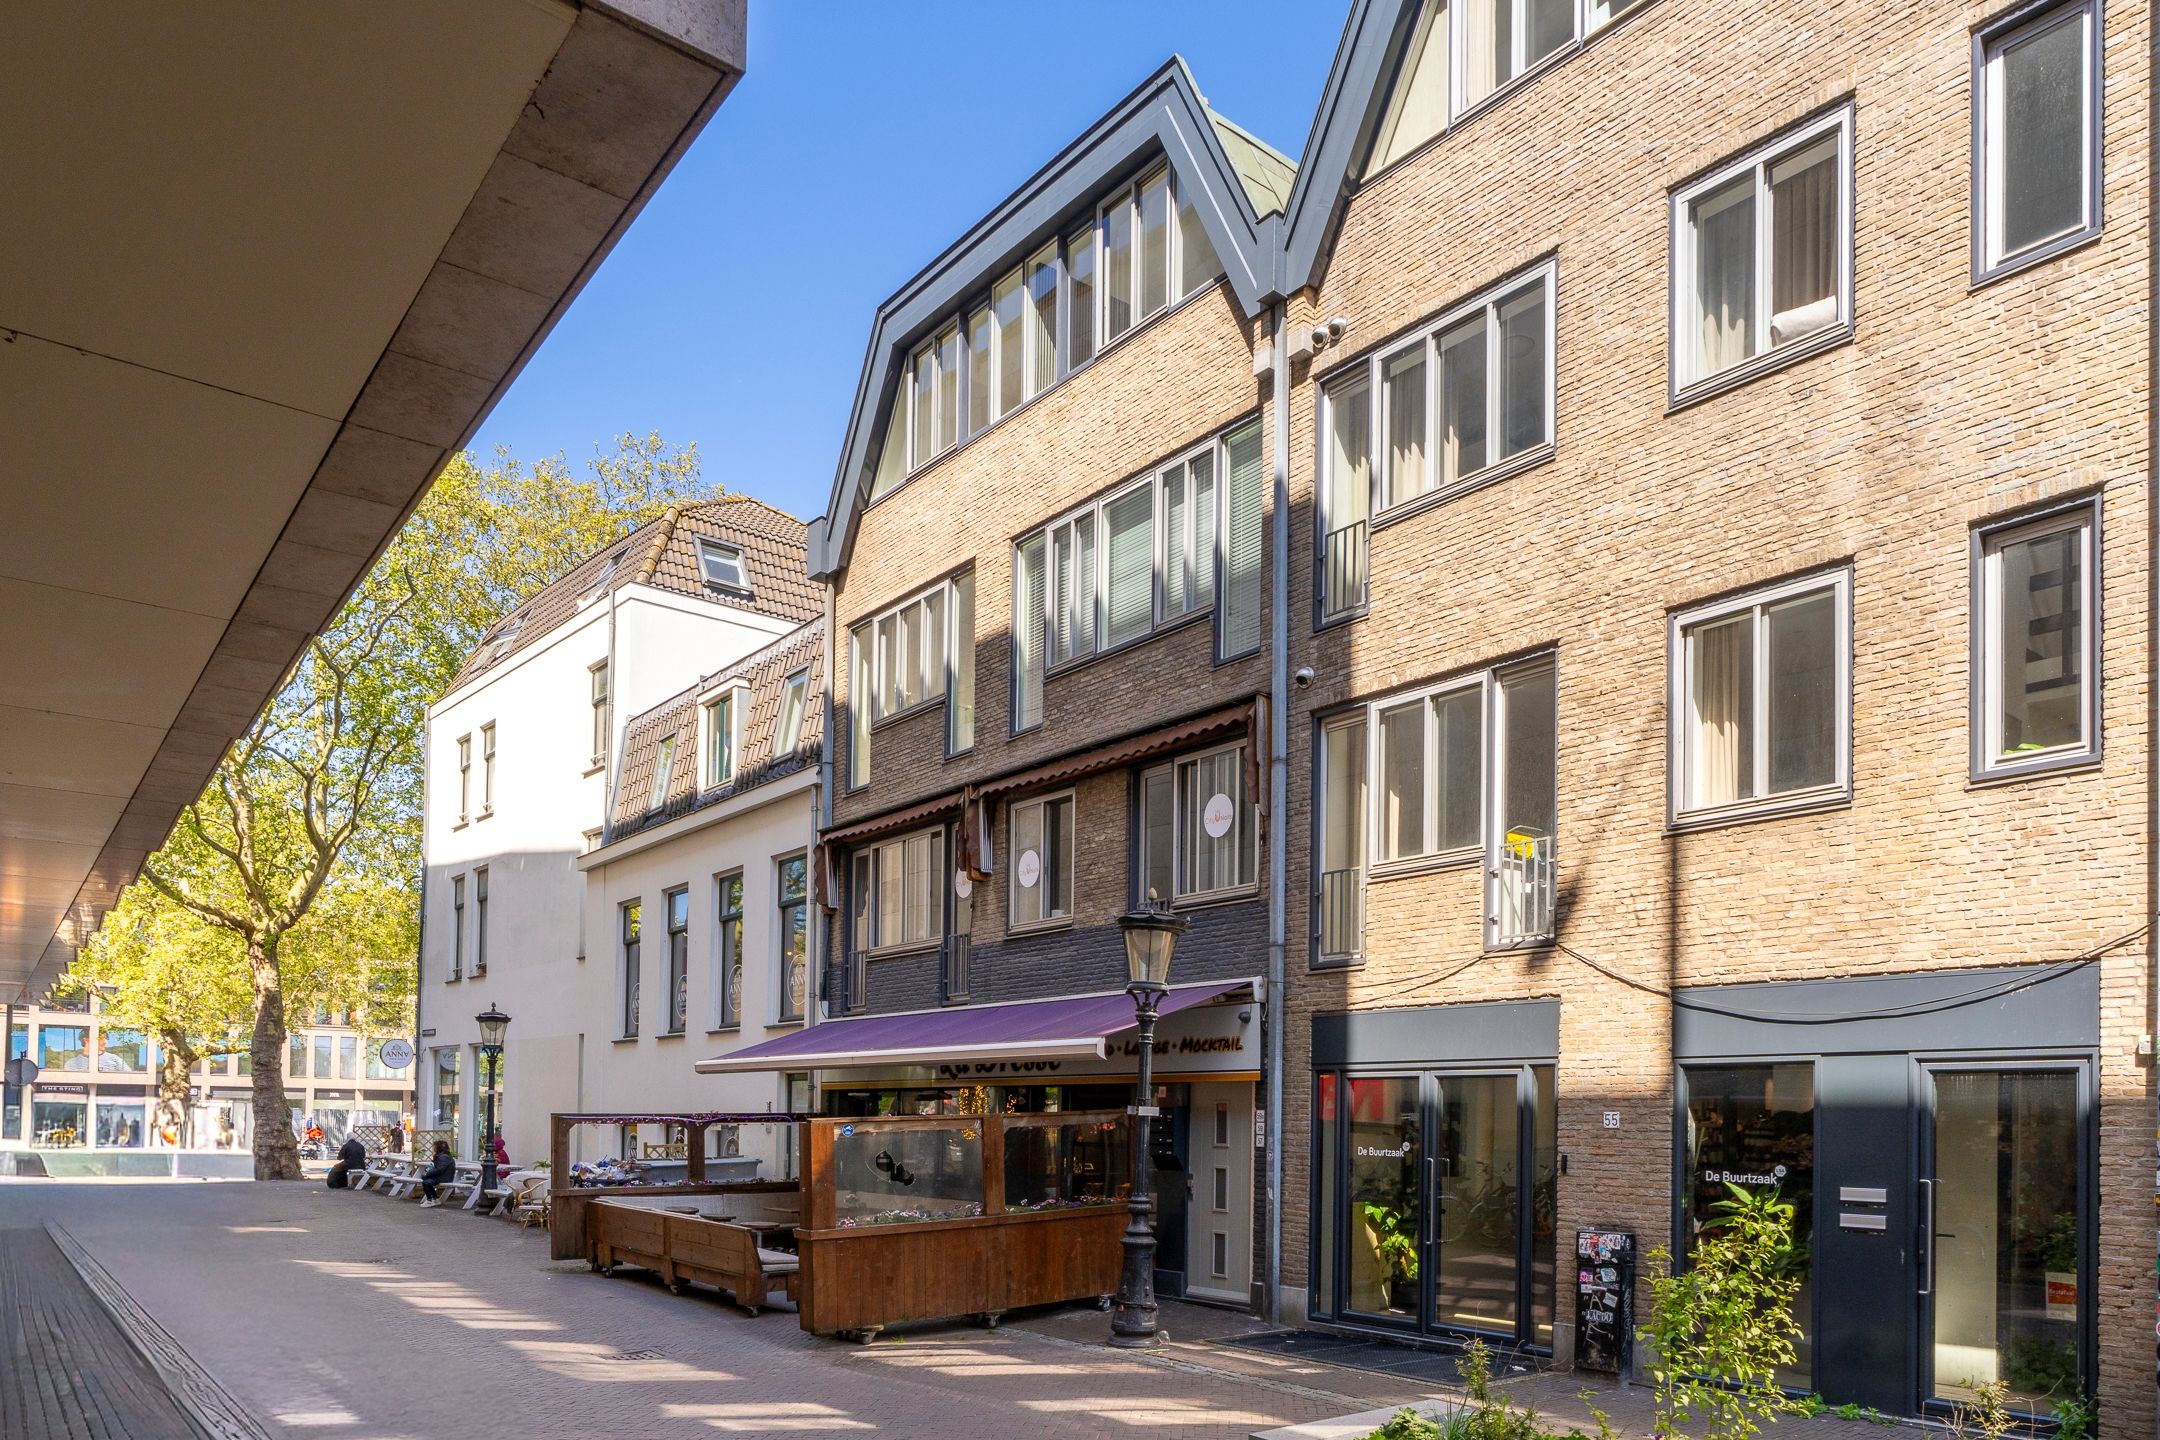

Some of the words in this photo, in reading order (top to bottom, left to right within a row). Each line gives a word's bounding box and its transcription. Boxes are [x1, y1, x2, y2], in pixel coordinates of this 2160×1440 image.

[790, 974, 805, 986] ANN
[1604, 1113, 1618, 1127] 55
[1357, 1146, 1368, 1156] De
[1368, 1146, 1405, 1158] Buurtzaak
[1705, 1170, 1720, 1182] De
[1722, 1171, 1778, 1185] Buurtzaak
